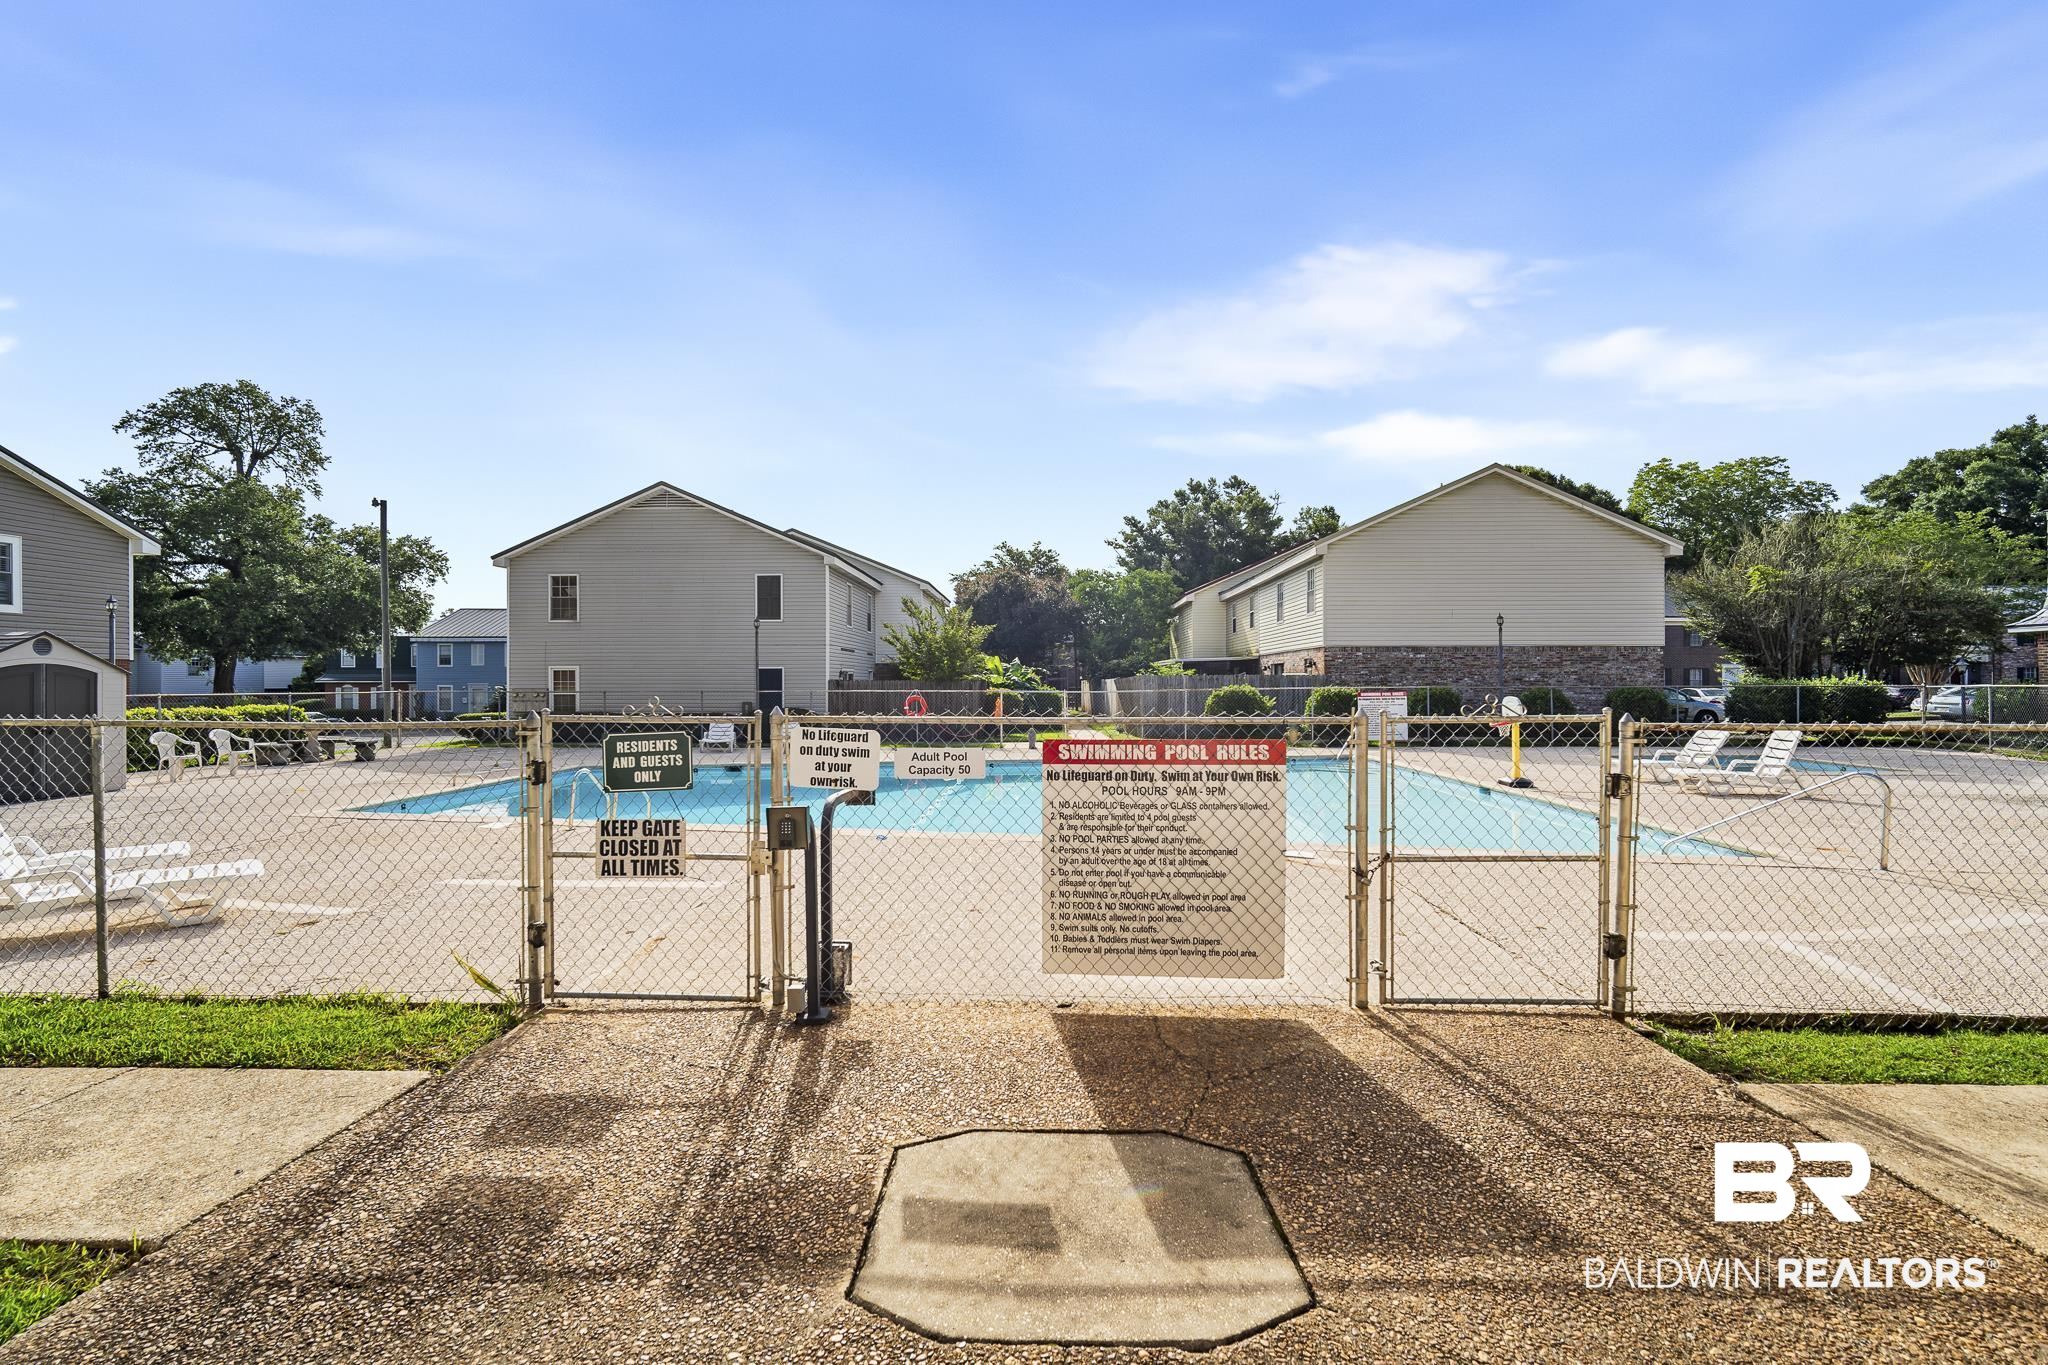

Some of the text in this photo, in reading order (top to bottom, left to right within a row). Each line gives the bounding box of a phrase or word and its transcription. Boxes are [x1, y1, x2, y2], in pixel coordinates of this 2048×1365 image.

[802, 729, 868, 743] No Lifeguard
[616, 739, 678, 754] RESIDENTS
[800, 745, 870, 758] on duty swim
[1058, 744, 1270, 760] SWIMMING POOL RULES
[612, 754, 683, 769] AND GUESTS
[911, 752, 968, 762] Adult Pool
[815, 761, 852, 773] at your
[908, 765, 971, 777] Capacity 50
[634, 770, 662, 783] ONLY
[810, 776, 858, 788] own risk.
[1046, 770, 1282, 783] No Lifeguard on Duty. Swim at Your Own Risk.
[1102, 786, 1130, 796] POOL
[1132, 786, 1168, 796] HOURS
[1176, 787, 1197, 796] 9AM
[1206, 787, 1226, 796] 9PM
[1059, 801, 1071, 810] NO
[1072, 801, 1118, 810] ALCOHOLIC
[1120, 802, 1158, 812] Beverages
[1170, 802, 1197, 810] GLASS
[1200, 802, 1238, 810] containers
[1240, 802, 1270, 810] allowed.
[1050, 812, 1056, 820] 2.
[1059, 812, 1094, 821] Residents
[1110, 812, 1136, 821] limited
[1137, 813, 1145, 821] to
[1154, 813, 1170, 822] pool
[1172, 814, 1197, 823] guests
[600, 820, 681, 837] KEEP GATE
[1080, 823, 1123, 834] responsible
[1137, 824, 1154, 832] their
[1156, 824, 1188, 832] conduct.
[1050, 835, 1056, 843] 3.
[1059, 834, 1071, 843] NO
[1073, 835, 1094, 843] POOL
[1097, 835, 1129, 844] PARTIES
[1131, 836, 1159, 844] allowed
[1161, 836, 1168, 844] at
[1170, 837, 1184, 846] any
[600, 839, 682, 856] CLOSED AT
[1050, 846, 1057, 854] 4.
[1058, 846, 1089, 854] Persons
[1091, 846, 1100, 854] 14
[1102, 848, 1122, 856] years
[1134, 847, 1155, 855] under
[1157, 848, 1176, 856] must
[1177, 847, 1187, 855] be
[1189, 848, 1238, 857] accompanied
[601, 859, 684, 876] ALL TIMES.
[1059, 857, 1068, 866] by
[1081, 857, 1099, 865] adult
[1133, 859, 1147, 867] age
[1149, 858, 1157, 866] of
[1168, 858, 1176, 866] at
[1178, 858, 1187, 866] all
[1188, 858, 1211, 866] times.
[1050, 868, 1056, 876] 5.
[1059, 868, 1070, 876] Do
[1085, 869, 1104, 877] enter
[1106, 869, 1122, 878] pool
[1124, 869, 1130, 877] if
[1130, 871, 1145, 879] you
[1147, 870, 1164, 878] have
[1173, 870, 1227, 878] communicable
[1059, 879, 1087, 887] disease
[1098, 881, 1117, 889] open
[1050, 890, 1056, 898] 6.
[1059, 890, 1071, 898] NO
[1072, 890, 1108, 899] RUNNING
[1120, 892, 1149, 900] ROUGH
[1151, 892, 1171, 900] PLAY
[1212, 893, 1228, 902] pool
[1050, 902, 1056, 910] 7.
[1059, 902, 1071, 910] NO
[1072, 902, 1095, 910] FOOD
[1096, 902, 1102, 910] &
[1118, 903, 1155, 911] SMOKING
[1157, 904, 1185, 912] allowed
[1187, 904, 1195, 912] in
[1196, 904, 1213, 913] pool
[1059, 912, 1071, 920] NO
[1072, 913, 1107, 921] ANIMALS
[1109, 914, 1137, 922] allowed
[1138, 914, 1146, 922] in
[1148, 914, 1164, 924] pool
[1050, 924, 1056, 932] 9.
[1059, 924, 1079, 932] Swim
[1100, 925, 1117, 934] only.
[1119, 924, 1130, 932] No
[1132, 925, 1160, 934] cutoffs.
[1050, 934, 1060, 942] 10.
[1063, 935, 1088, 943] Babies
[1090, 935, 1095, 943] &
[1097, 935, 1128, 944] Toddlers
[1130, 936, 1150, 944] must
[1170, 937, 1191, 945] Swim
[1193, 937, 1222, 946] Diapers.
[1062, 945, 1092, 954] Remove
[1093, 946, 1102, 954] all
[1104, 947, 1136, 956] personal
[1137, 947, 1158, 955] items
[1160, 948, 1179, 956] upon
[1181, 948, 1207, 958] leaving
[1222, 949, 1239, 958] pool
